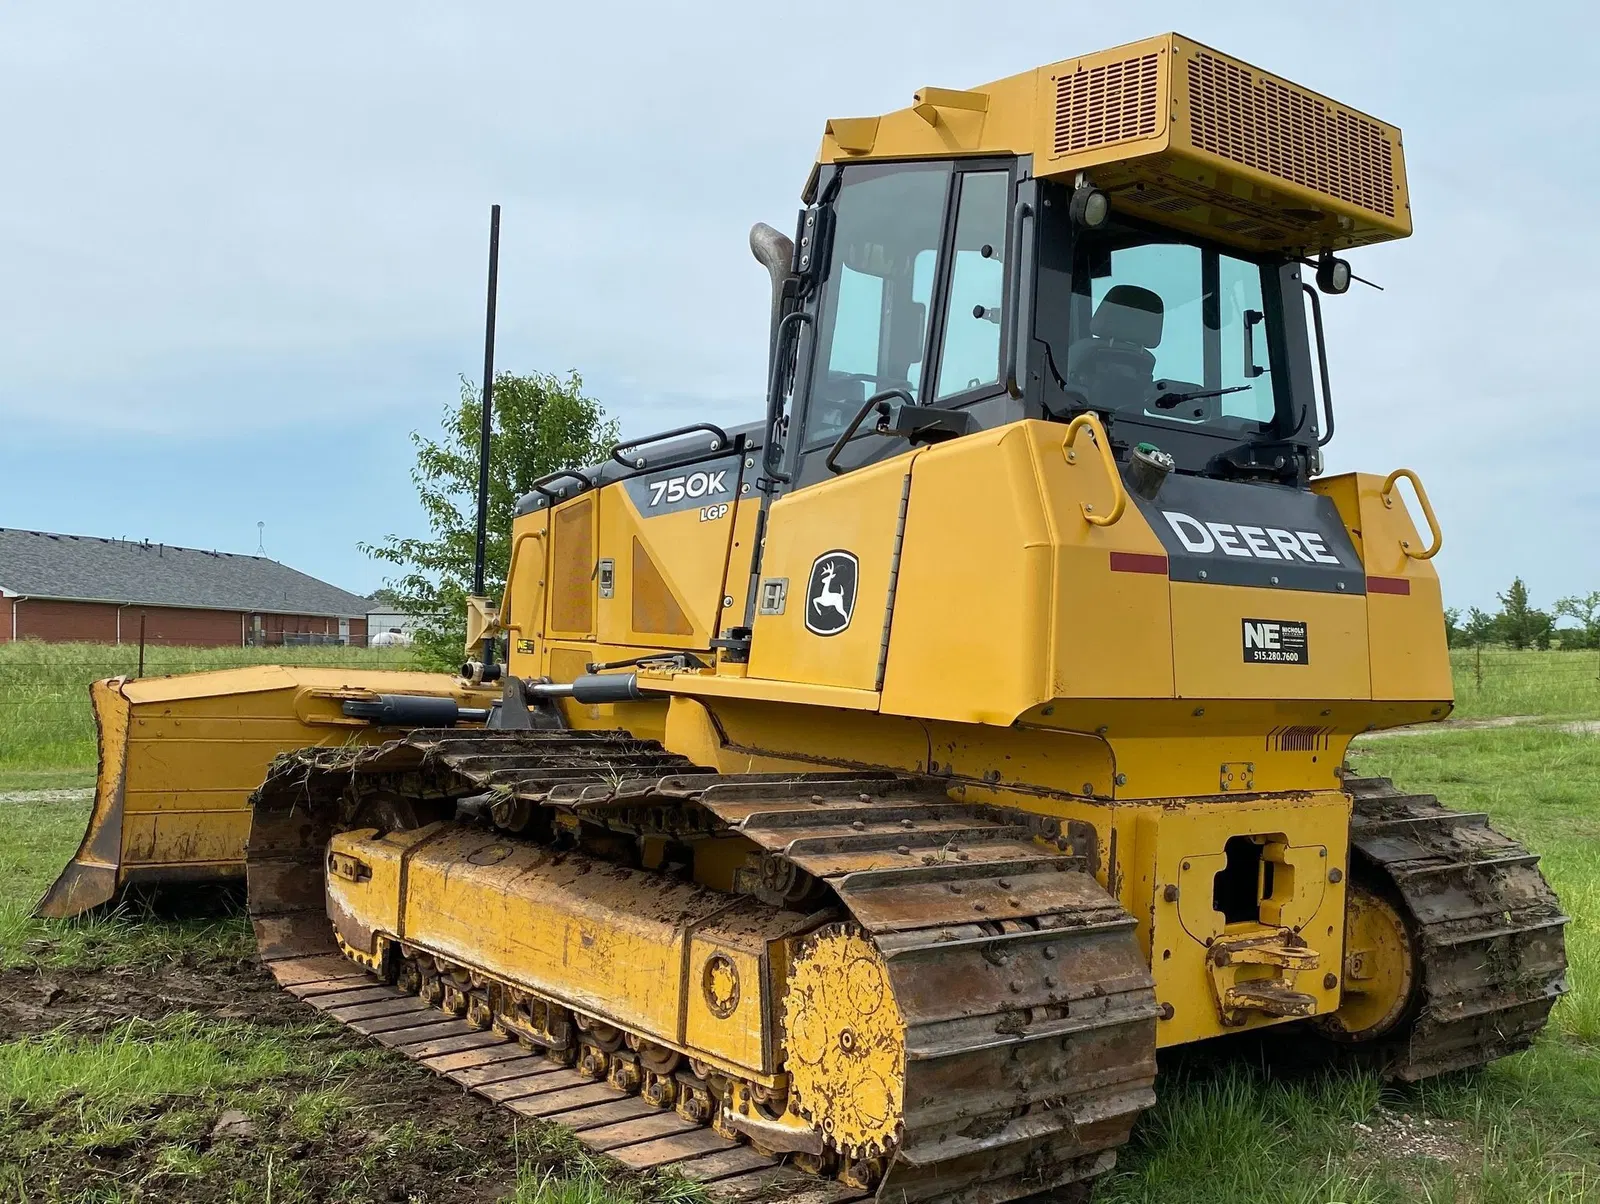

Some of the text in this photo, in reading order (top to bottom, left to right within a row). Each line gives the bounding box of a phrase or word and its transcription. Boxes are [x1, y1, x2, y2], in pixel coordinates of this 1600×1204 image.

[649, 469, 729, 507] 750K
[700, 504, 728, 522] LGP
[1161, 510, 1341, 565] DEERE
[1244, 622, 1281, 649] NE
[1281, 626, 1304, 634] NICHOLS
[1254, 650, 1299, 662] 515.280.7600
